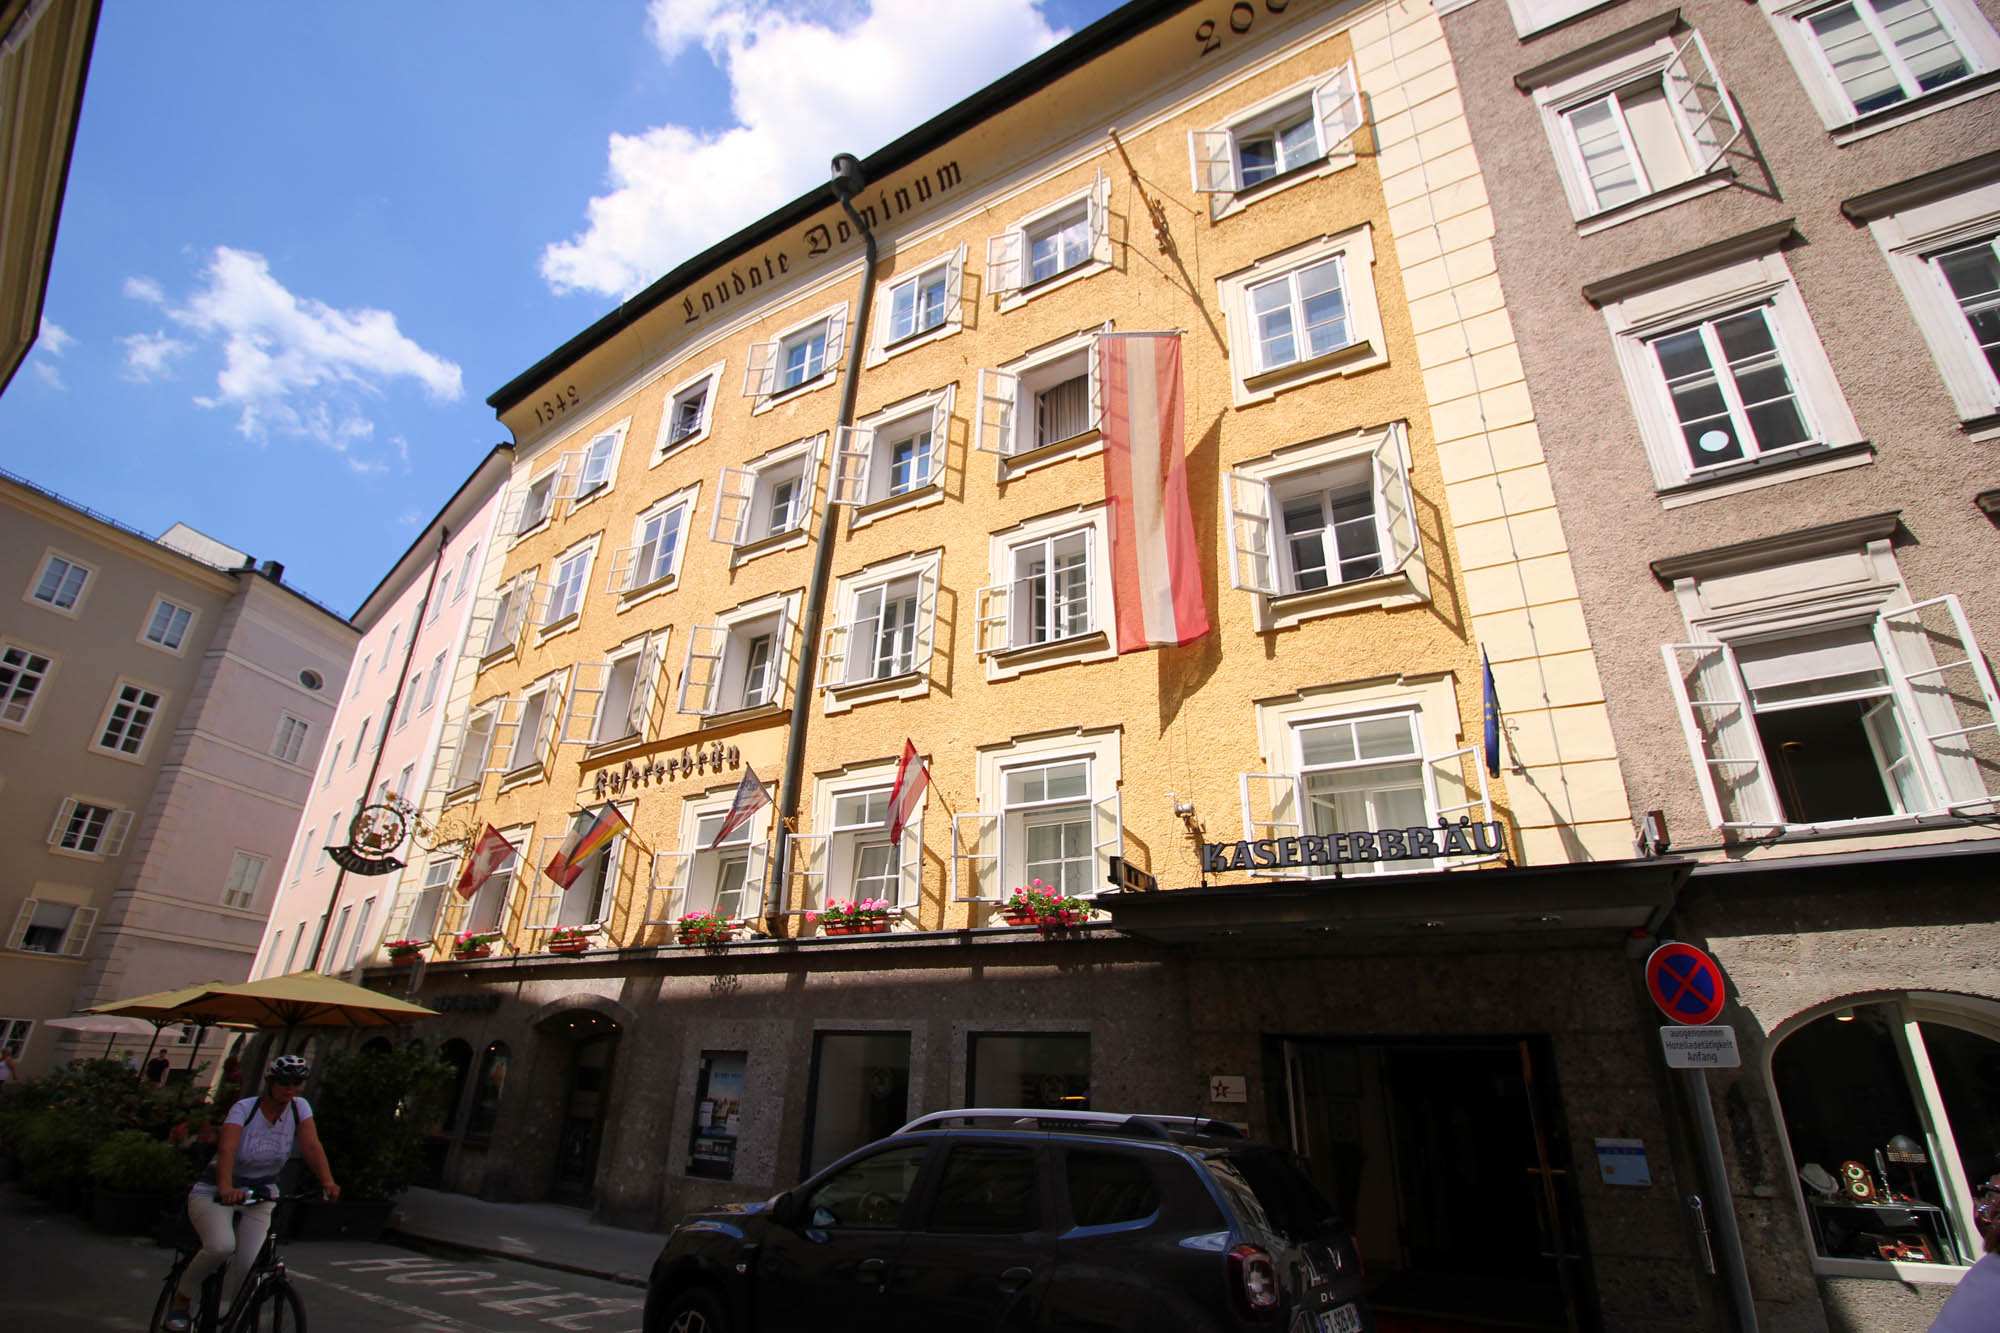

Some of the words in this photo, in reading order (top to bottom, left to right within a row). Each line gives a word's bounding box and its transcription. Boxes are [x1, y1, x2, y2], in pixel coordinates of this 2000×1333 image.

[334, 848, 396, 876] HOTEL
[1202, 816, 1502, 872] KASERERBRÄU
[1687, 1052, 1719, 1063] Anfang
[330, 1257, 646, 1331] HOTEL
